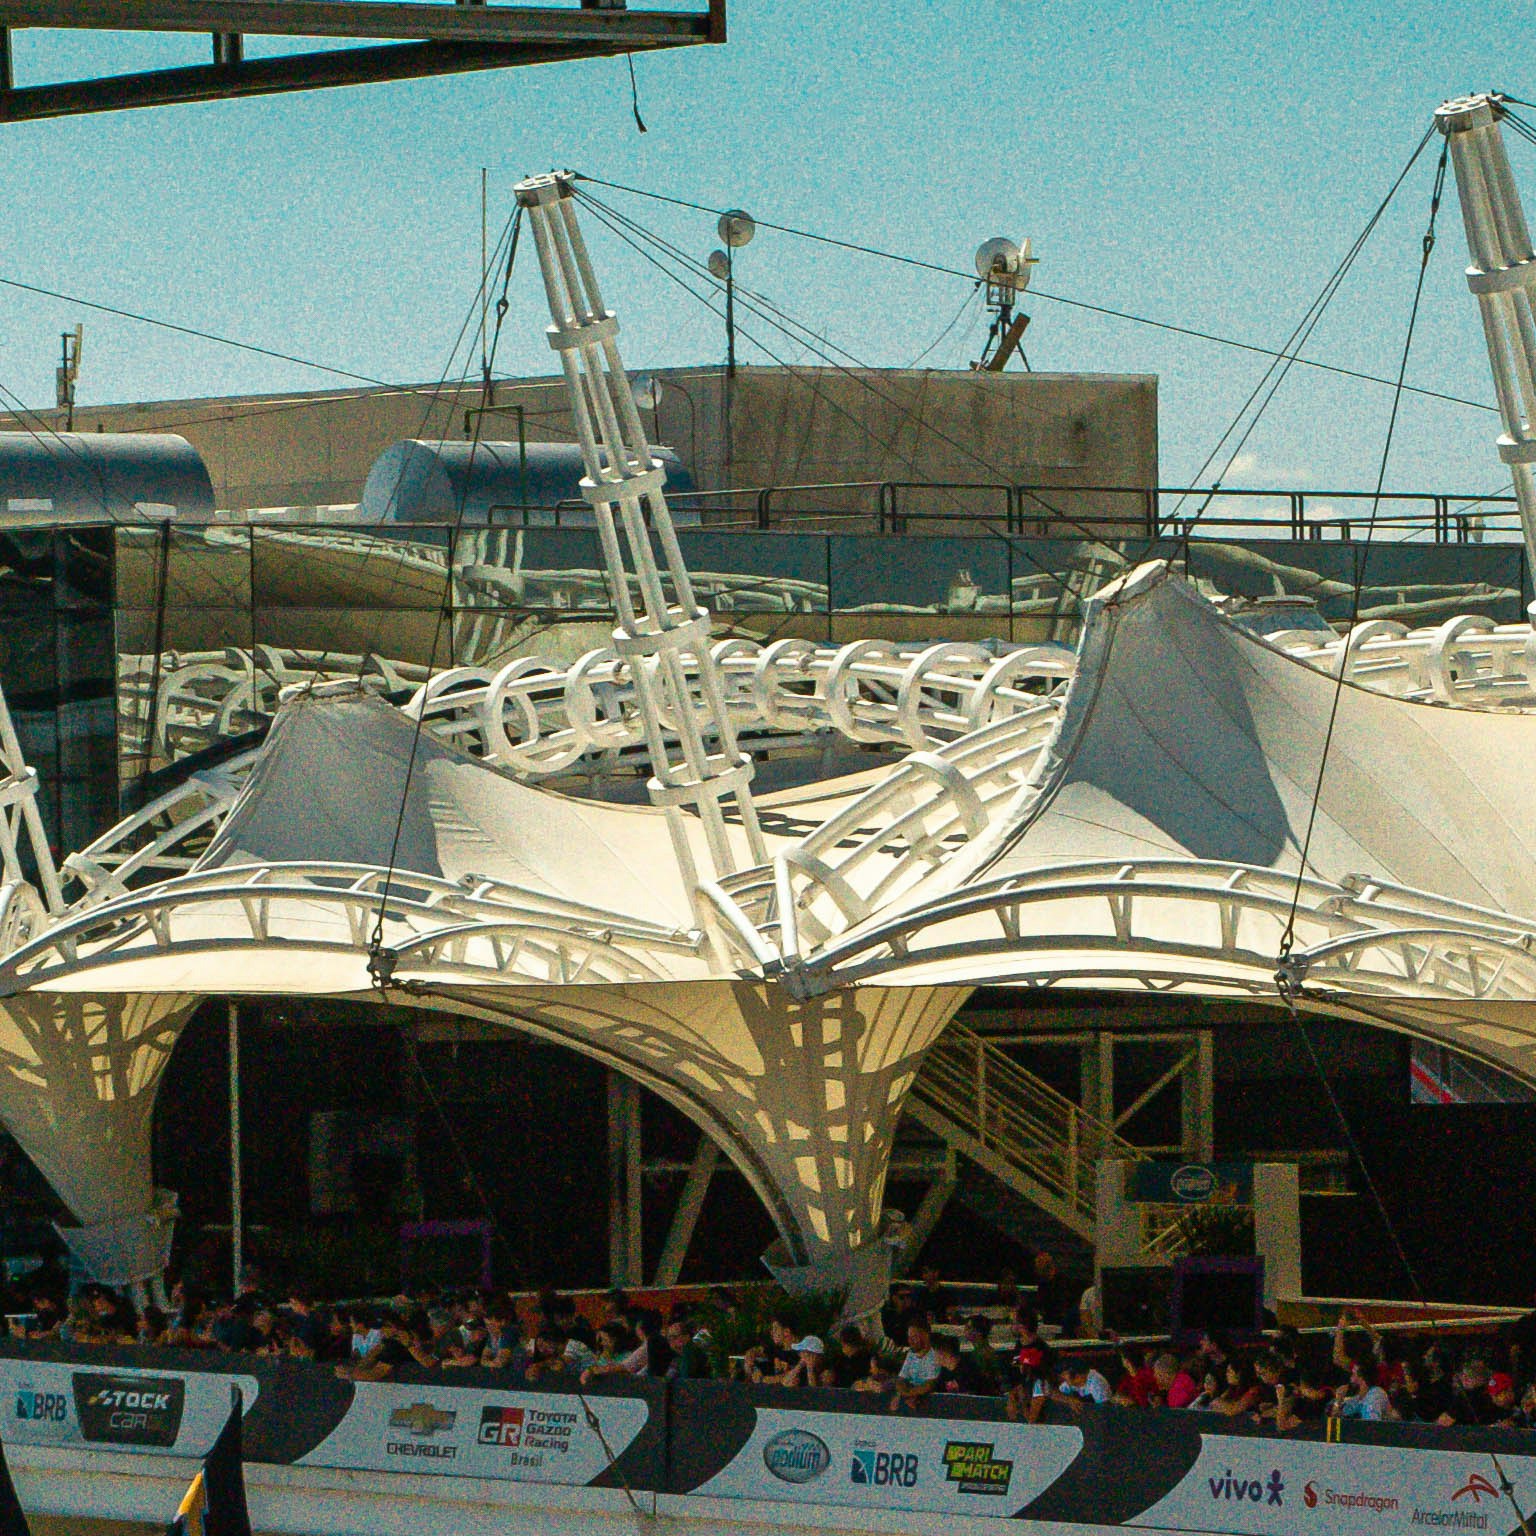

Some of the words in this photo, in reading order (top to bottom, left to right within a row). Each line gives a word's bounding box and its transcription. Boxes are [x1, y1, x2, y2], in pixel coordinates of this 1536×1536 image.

[33, 1392, 68, 1421] BRB
[96, 1389, 170, 1410] STOCK
[529, 1409, 578, 1424] TOYOTA
[526, 1423, 572, 1437] GAZOO
[386, 1442, 457, 1459] CHEVROLET
[524, 1436, 569, 1453] Racing
[510, 1452, 544, 1467] Brasil
[874, 1452, 919, 1488] BRB
[1208, 1469, 1264, 1502] vivo
[1324, 1488, 1399, 1513] Snapdragon
[1411, 1508, 1488, 1530] ArcelorMittal
